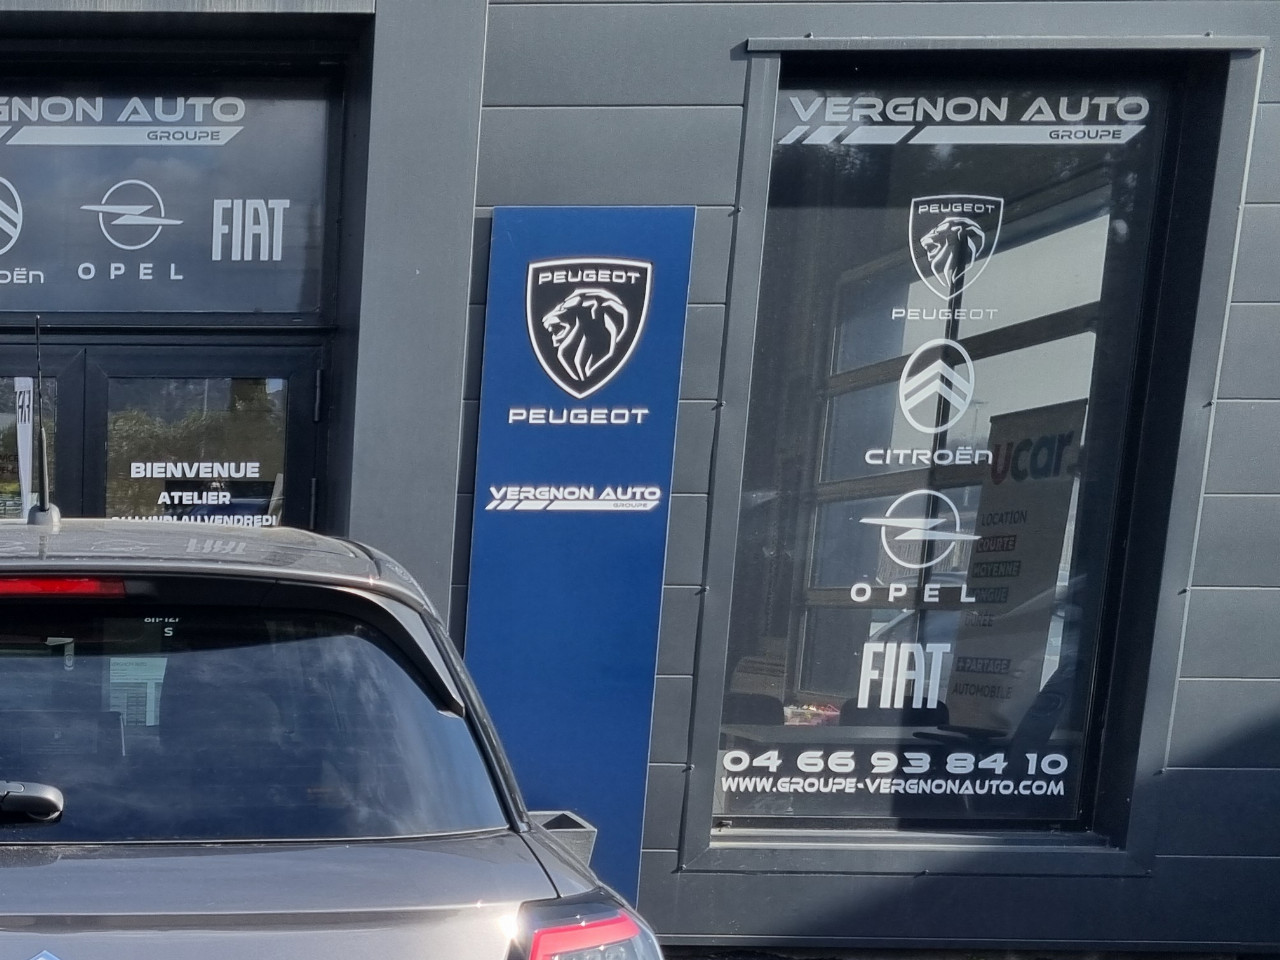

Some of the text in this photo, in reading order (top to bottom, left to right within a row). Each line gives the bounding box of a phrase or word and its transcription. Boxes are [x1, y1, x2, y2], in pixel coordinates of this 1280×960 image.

[116, 96, 246, 122] AUTO
[789, 96, 1150, 122] VERGNON AUTO
[146, 130, 221, 141] GROUPE
[1048, 129, 1123, 140] GROUPE
[918, 202, 996, 214] PEUGEOT
[212, 199, 291, 261] FIAT
[77, 262, 184, 281] OPEL
[537, 269, 641, 285] PEUGEOT
[891, 307, 999, 321] PEUGEOT
[508, 407, 650, 424] PEUGEOT
[864, 446, 993, 465] CITROËN
[130, 462, 260, 478] BIENVENUE
[157, 491, 231, 505] ATELIER
[489, 486, 661, 501] VERGNON AUTO
[981, 510, 1027, 527] LOCATION
[850, 583, 976, 602] OPEL
[967, 588, 1008, 602] ONGUE
[857, 643, 951, 709] FIAT
[952, 683, 1013, 699] AUTOMOBILE
[722, 750, 1068, 775] 04 66 93 84 10
[721, 777, 1065, 796] WWW.GROUPE-VERGNONAUTO.COM
